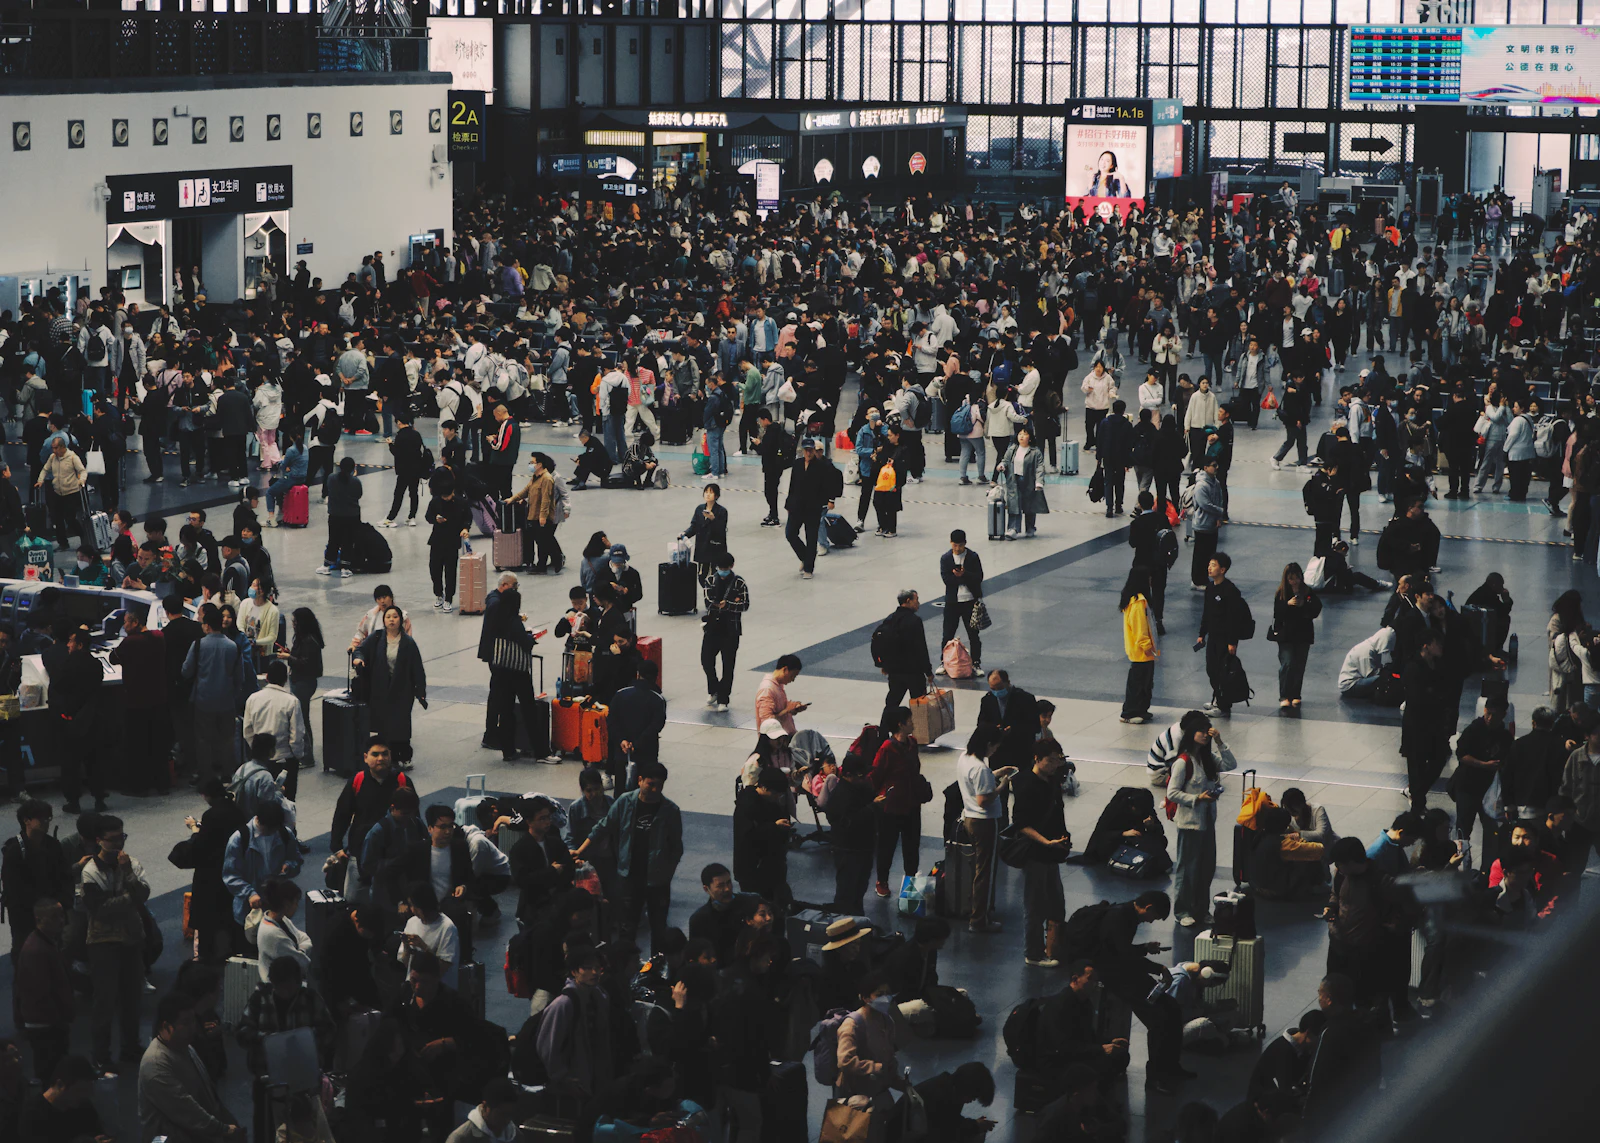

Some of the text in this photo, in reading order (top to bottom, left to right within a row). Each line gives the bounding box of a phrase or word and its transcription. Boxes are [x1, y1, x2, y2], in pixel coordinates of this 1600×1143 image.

[1506, 45, 1575, 54] 文明伴我行
[1505, 63, 1574, 72] 公德在我心
[452, 101, 479, 125] 2A
[648, 111, 682, 126] 姑苏好礼
[453, 132, 479, 142] 检票口
[1077, 129, 1137, 139] #招行卡好用#
[211, 180, 239, 193] 女卫生间
[267, 183, 285, 193] 饮用水
[136, 192, 156, 203] 饮用水
